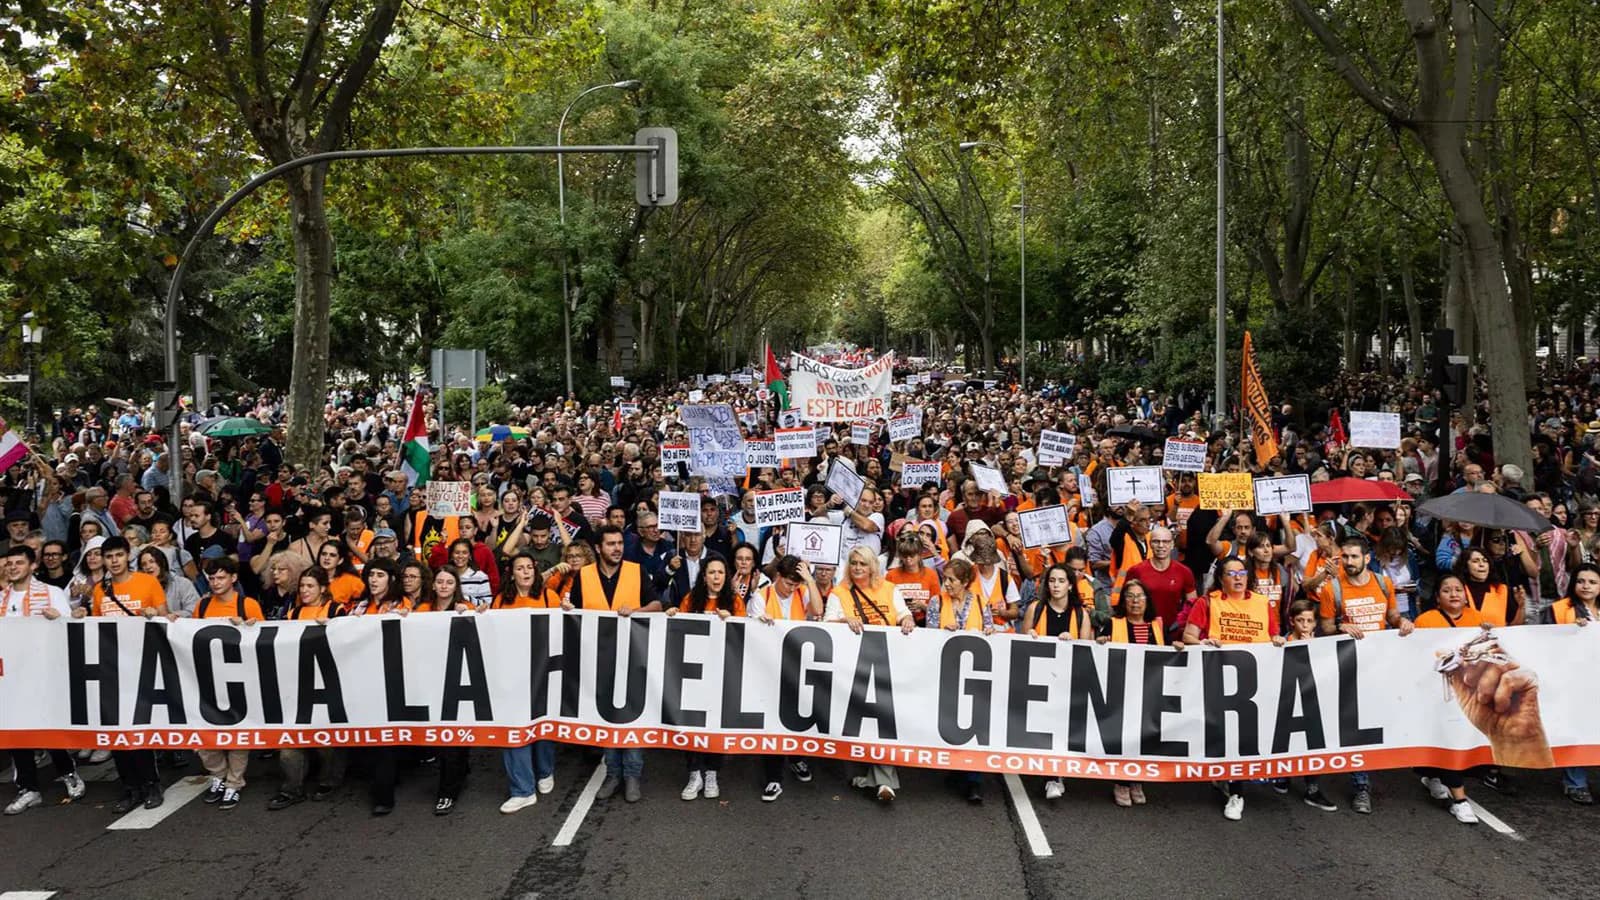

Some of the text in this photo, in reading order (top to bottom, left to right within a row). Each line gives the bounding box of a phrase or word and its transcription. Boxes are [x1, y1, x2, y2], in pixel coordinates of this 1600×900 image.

[817, 380, 869, 398] NO PARA
[807, 398, 884, 418] ESPECULAR
[662, 449, 672, 459] NO
[756, 490, 803, 508] NO al FRAUDE
[1199, 489, 1247, 500] ESTAS CASAS
[67, 614, 1384, 758] HACIA LA HUELGA GENERAL
[96, 732, 204, 746] BAJADA
[216, 731, 267, 746] DEL
[278, 729, 414, 745] ALQUILER
[425, 728, 476, 743] 50%
[507, 722, 709, 749] EXPROPIACIÓN
[723, 735, 838, 756] FONDOS
[850, 744, 951, 766] BUITRE
[985, 754, 1161, 779] CONTRATOS
[1174, 753, 1366, 779] INDEFINIDOS
